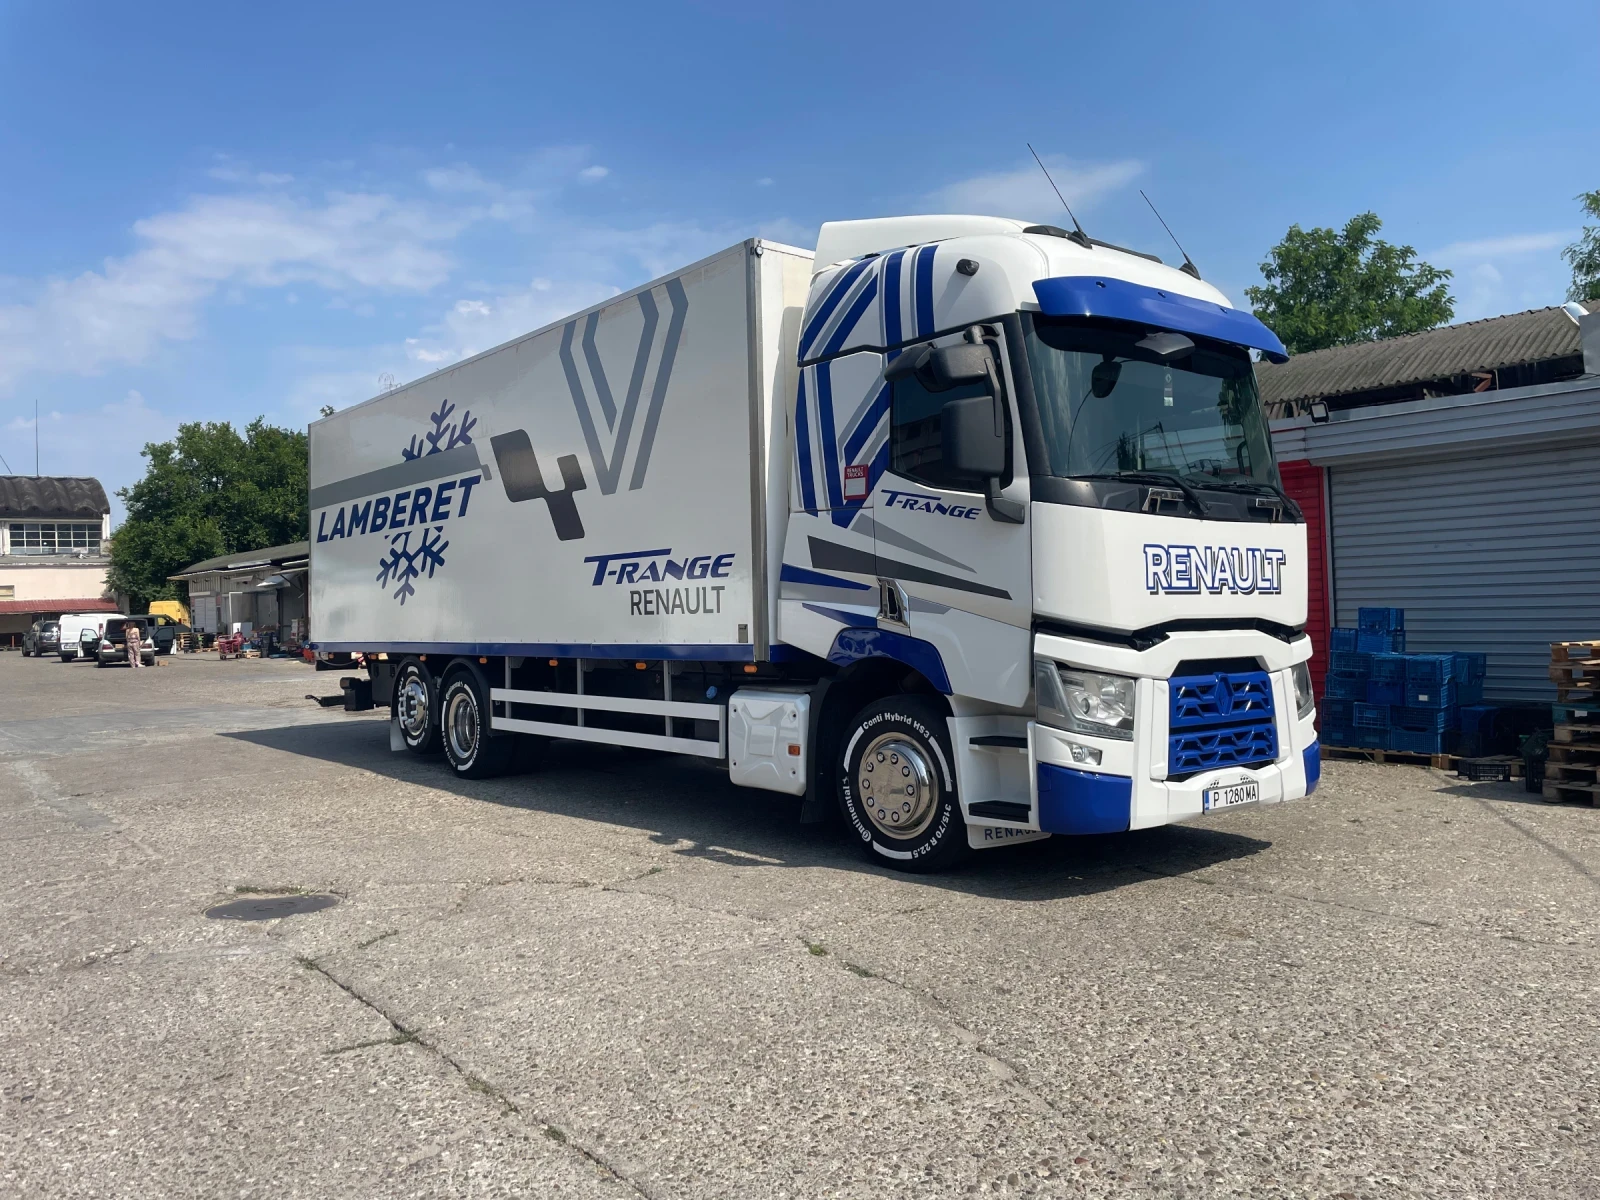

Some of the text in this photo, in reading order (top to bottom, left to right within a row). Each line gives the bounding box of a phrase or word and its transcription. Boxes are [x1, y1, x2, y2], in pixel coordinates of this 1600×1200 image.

[316, 474, 482, 543] LAMBERET
[881, 489, 982, 520] T-RANGE
[583, 548, 736, 587] T-RANGE
[1143, 543, 1287, 595] RENAULT
[630, 585, 726, 616] RENAULT
[862, 712, 930, 739] Conti Hybrid HS3
[842, 785, 872, 843] Continental
[1213, 791, 1220, 807] P
[912, 803, 952, 859] 315/70 R 22.5
